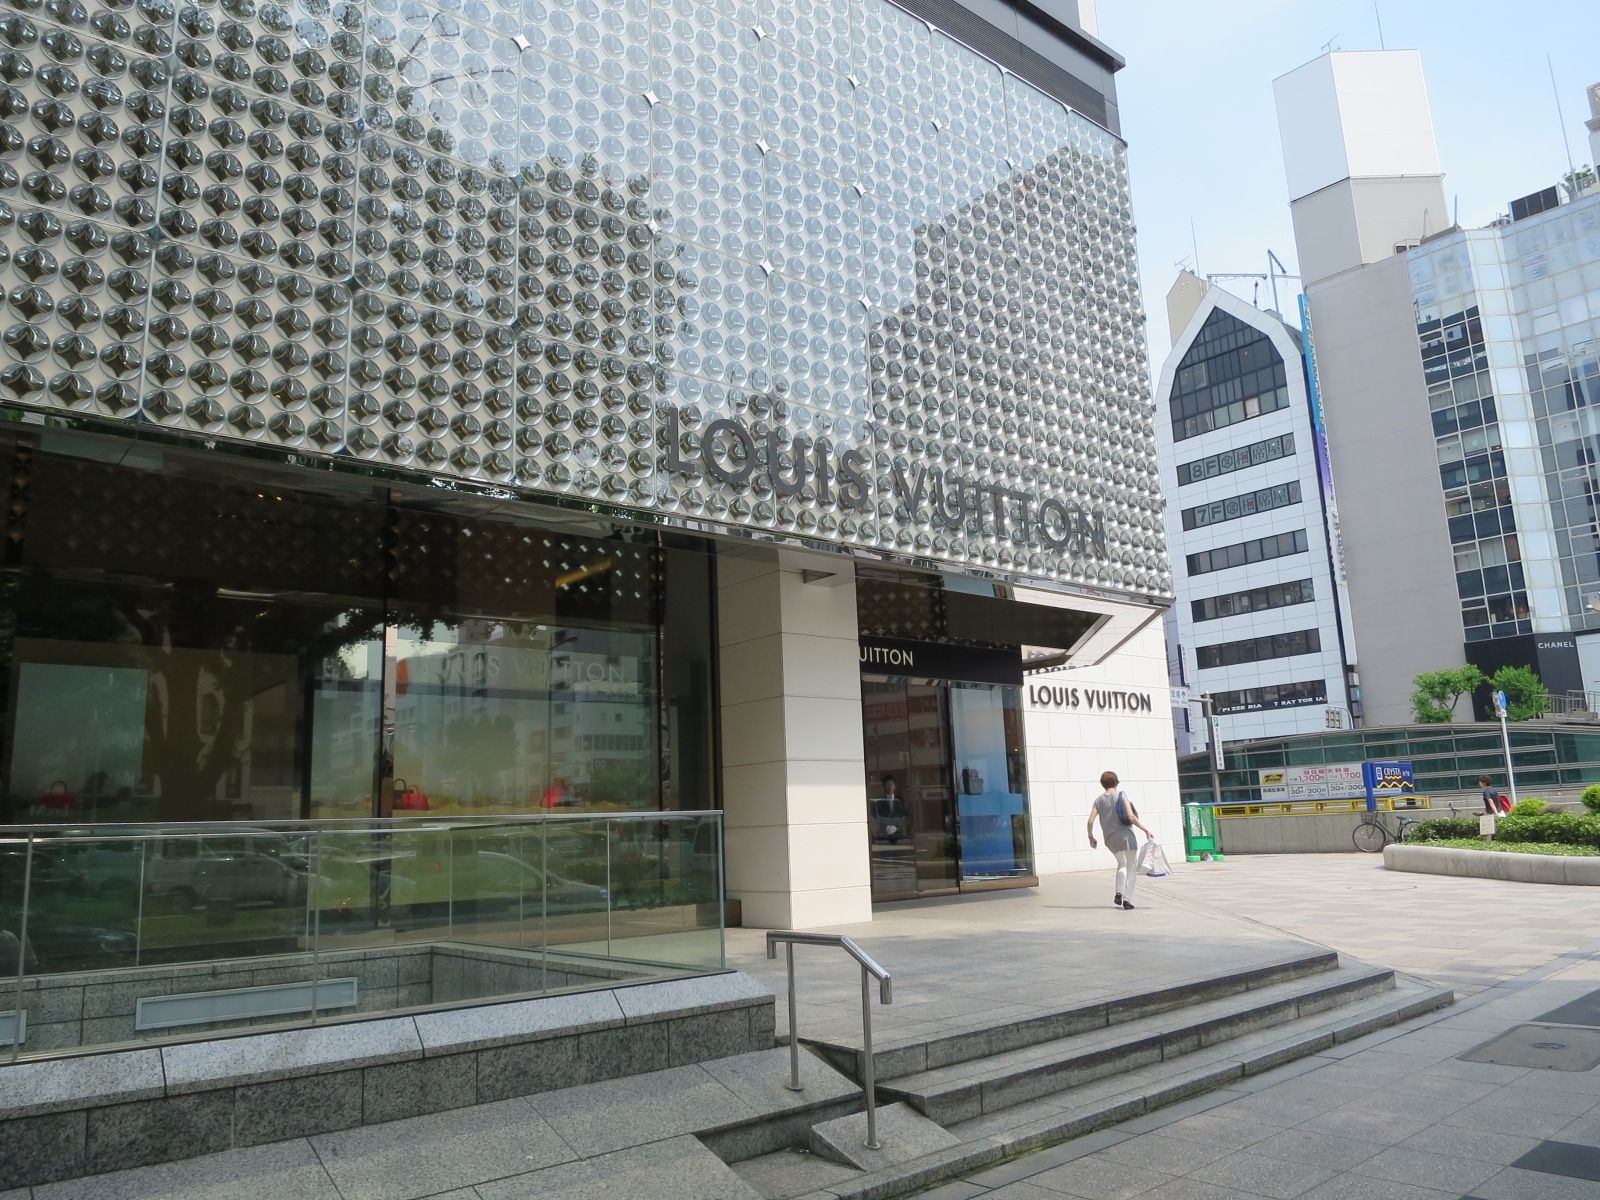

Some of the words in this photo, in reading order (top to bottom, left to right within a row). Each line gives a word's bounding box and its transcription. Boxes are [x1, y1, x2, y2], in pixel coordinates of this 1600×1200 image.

[1192, 459, 1216, 478] 8F
[664, 406, 875, 507] LOUIS
[892, 460, 1108, 562] VUITTON
[1197, 505, 1222, 523] 7F
[1538, 641, 1575, 649] CHANEL
[1029, 684, 1080, 708] LOUIS
[1084, 688, 1152, 713] VUITTON
